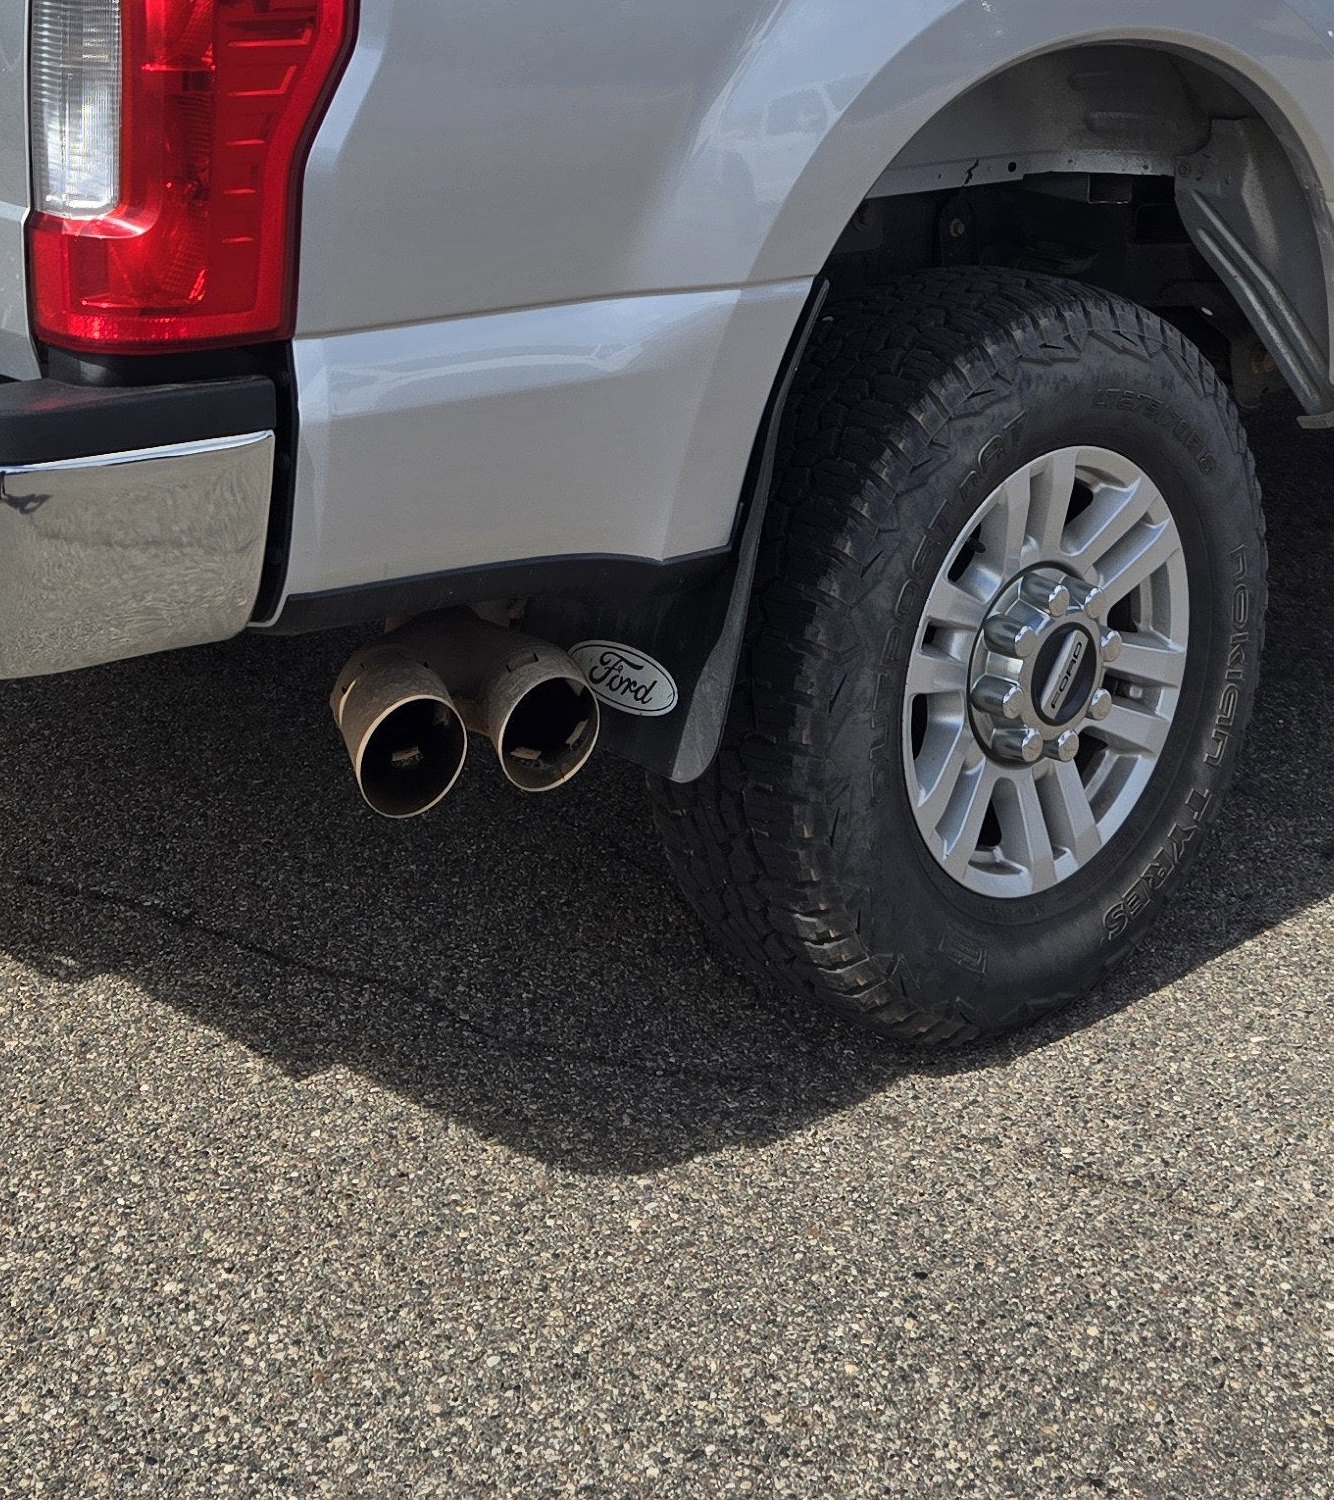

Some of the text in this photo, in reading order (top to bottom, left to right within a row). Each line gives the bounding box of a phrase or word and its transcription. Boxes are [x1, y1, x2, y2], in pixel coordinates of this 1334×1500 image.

[588, 651, 657, 704] Ford
[1050, 641, 1083, 709] FORD
[1101, 787, 1215, 941] TYRES
